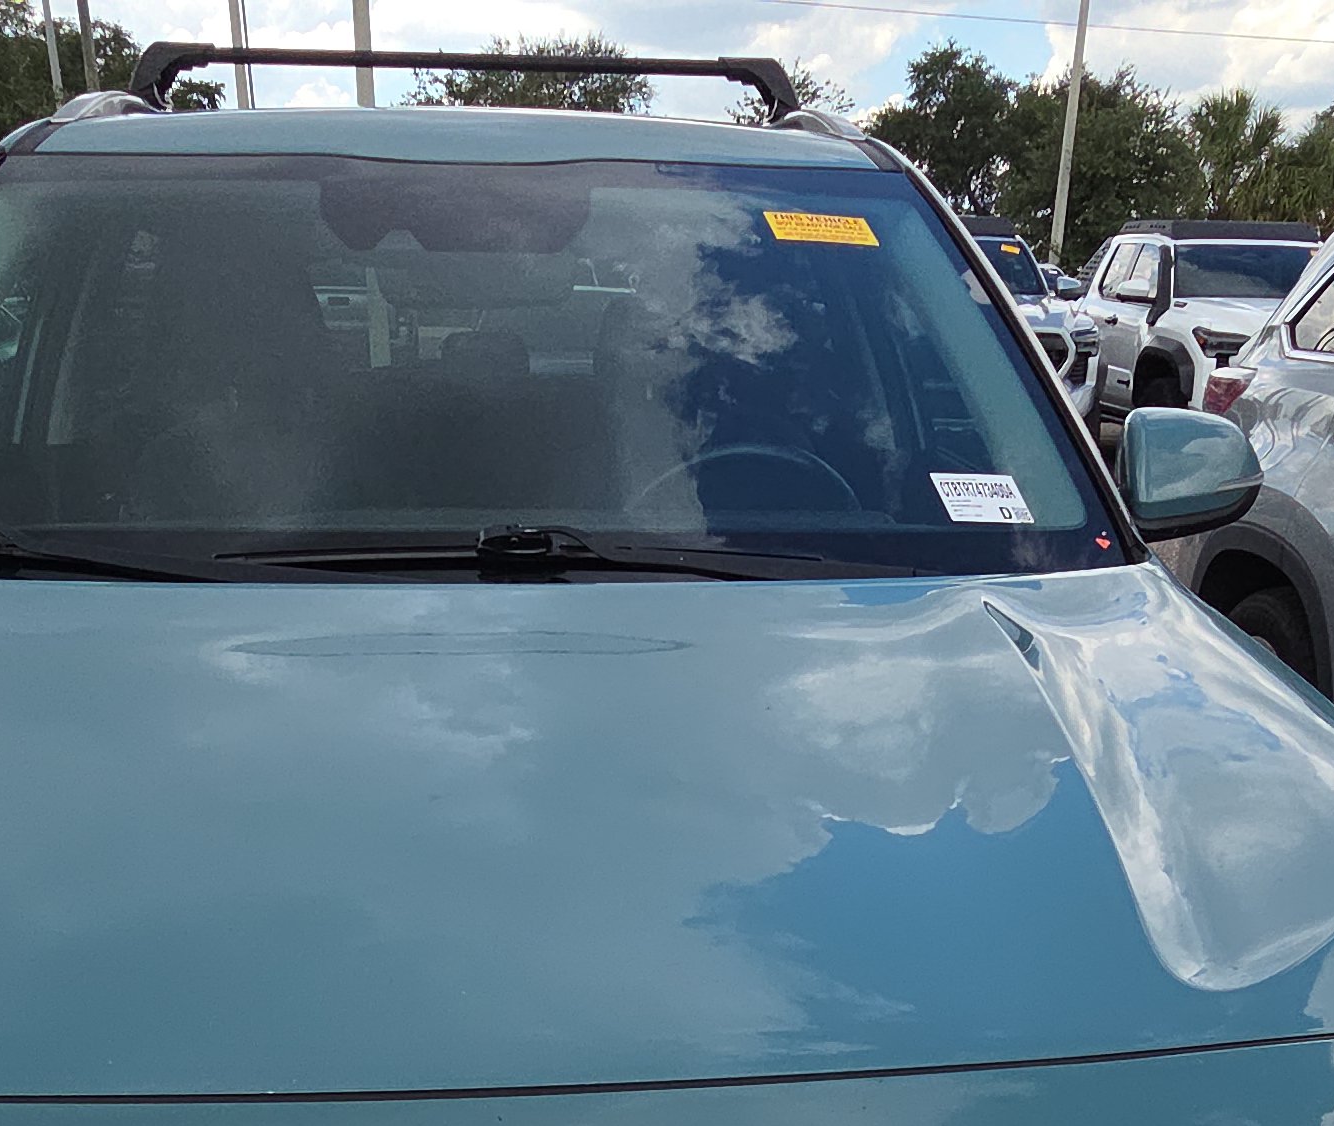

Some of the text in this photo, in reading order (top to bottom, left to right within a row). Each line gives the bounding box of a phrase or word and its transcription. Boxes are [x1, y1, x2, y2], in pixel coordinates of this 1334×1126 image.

[773, 213, 859, 225] THIS VEHICLE
[999, 507, 1012, 519] D
